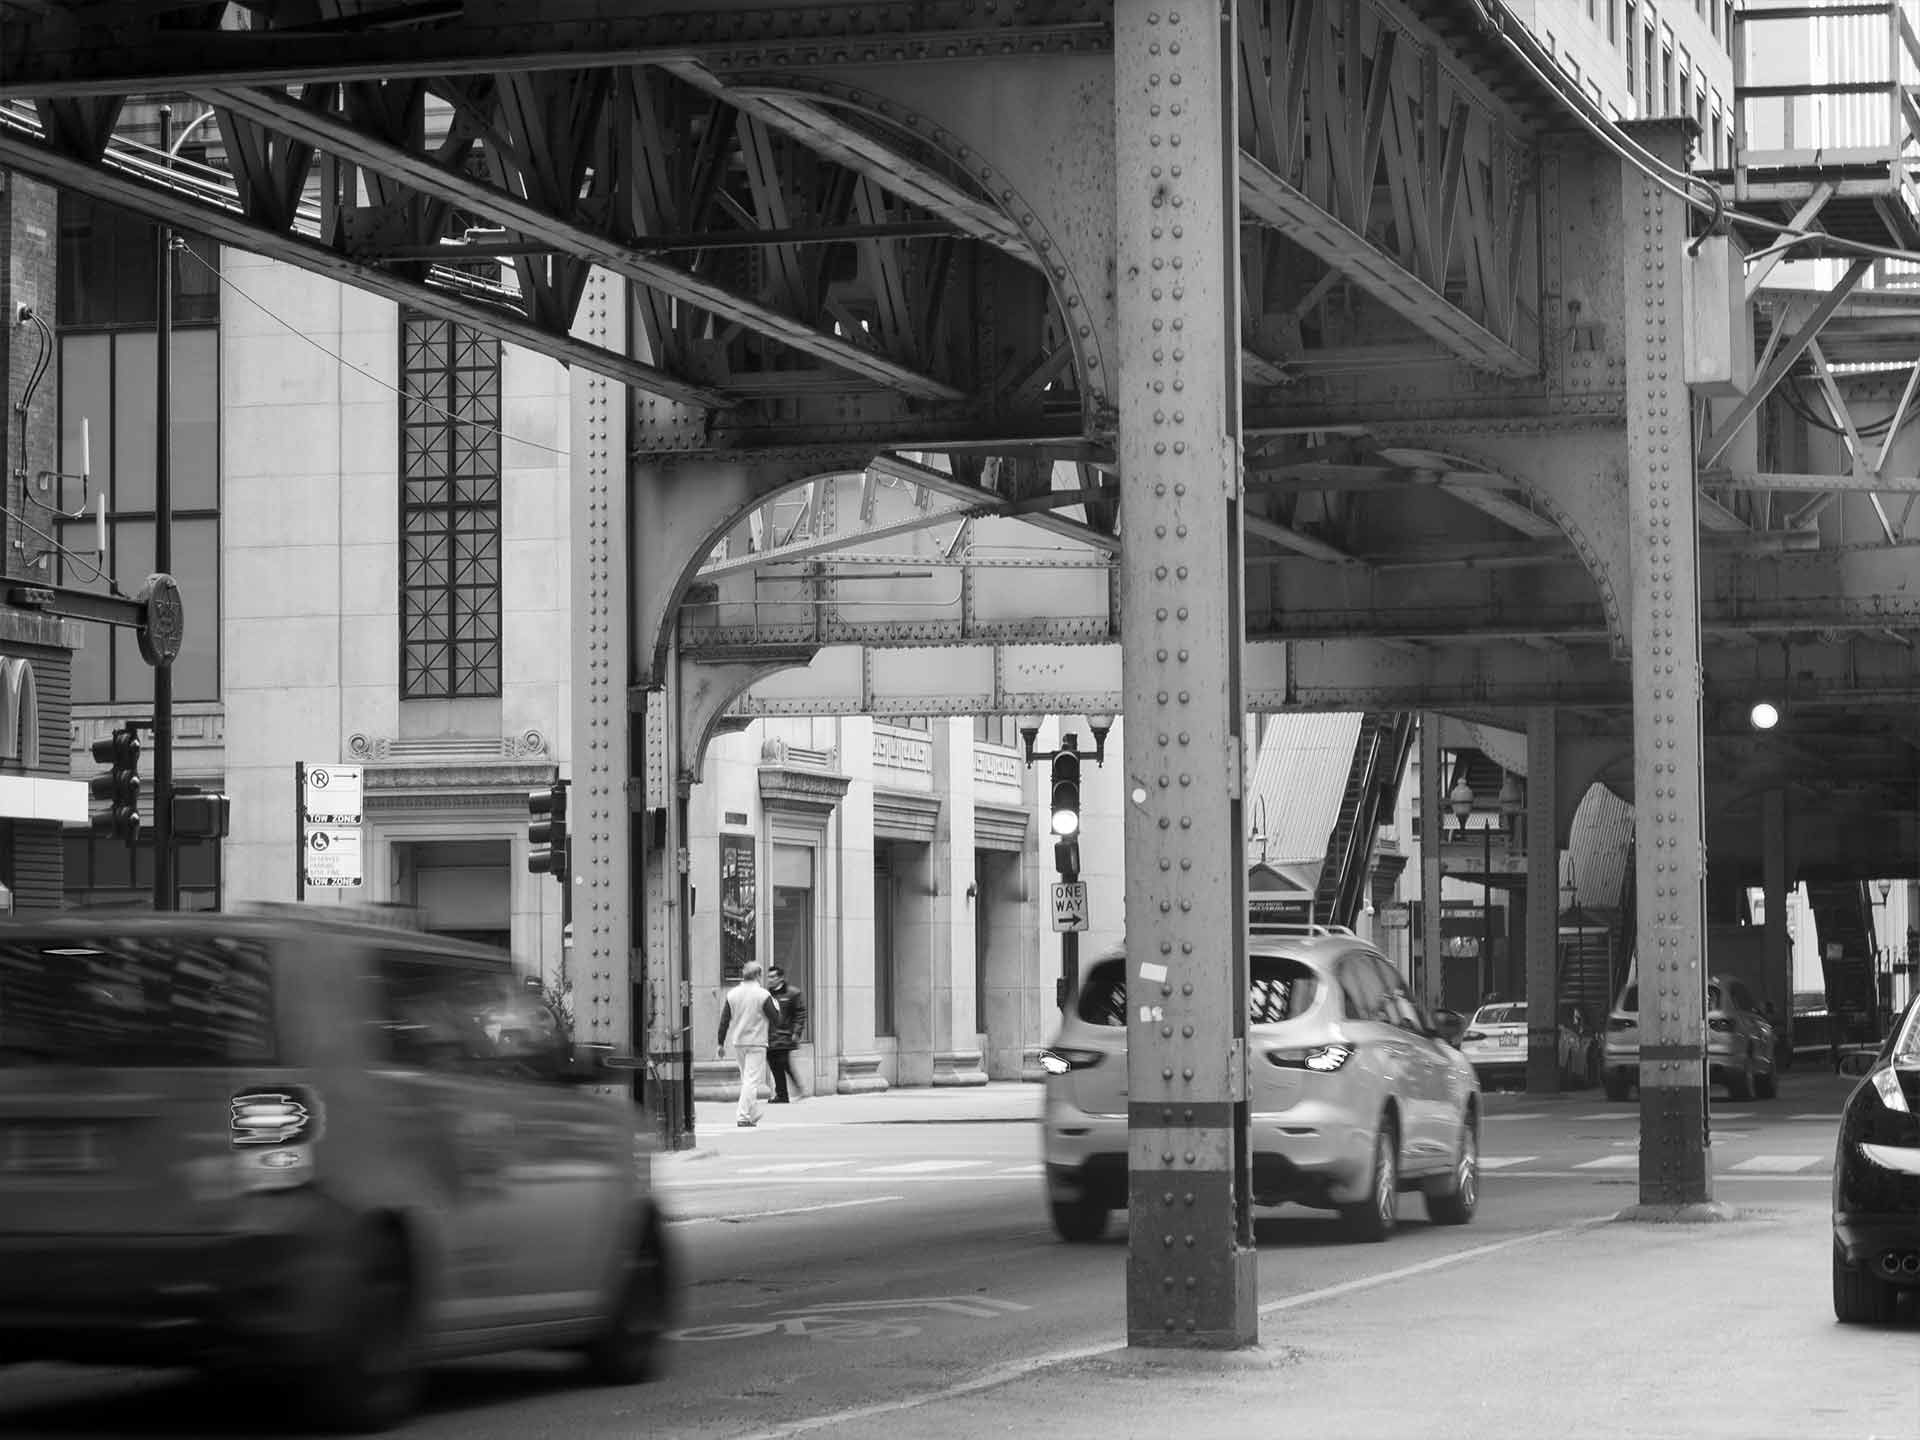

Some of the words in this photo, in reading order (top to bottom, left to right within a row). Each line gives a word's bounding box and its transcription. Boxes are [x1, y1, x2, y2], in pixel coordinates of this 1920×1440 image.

[310, 815, 328, 823] TOW
[332, 815, 356, 823] ZONE
[310, 879, 328, 887] TOW
[331, 879, 354, 887] ZONE
[1056, 886, 1081, 898] ONE
[1055, 899, 1082, 912] WAY
